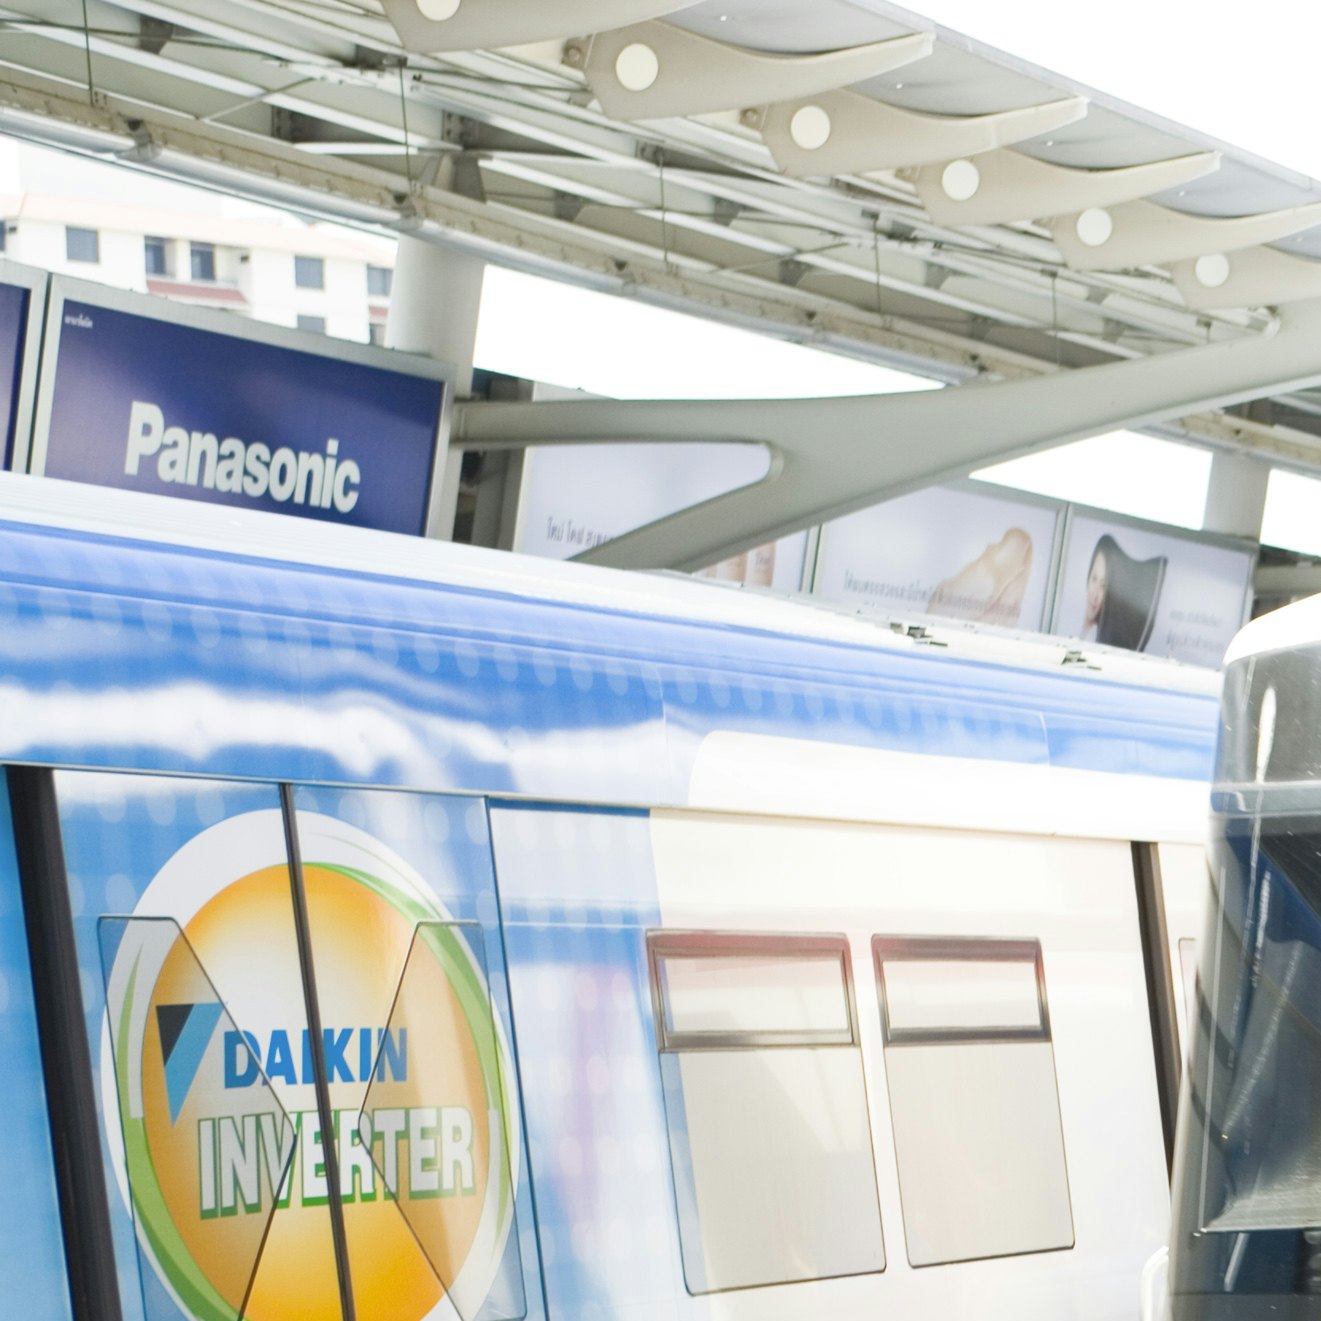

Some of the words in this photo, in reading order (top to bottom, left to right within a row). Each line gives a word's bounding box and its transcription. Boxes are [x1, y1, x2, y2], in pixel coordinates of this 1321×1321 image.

[124, 400, 361, 513] Panasonic
[224, 1028, 407, 1089] DAIKIN
[198, 1108, 476, 1220] INVERTER
